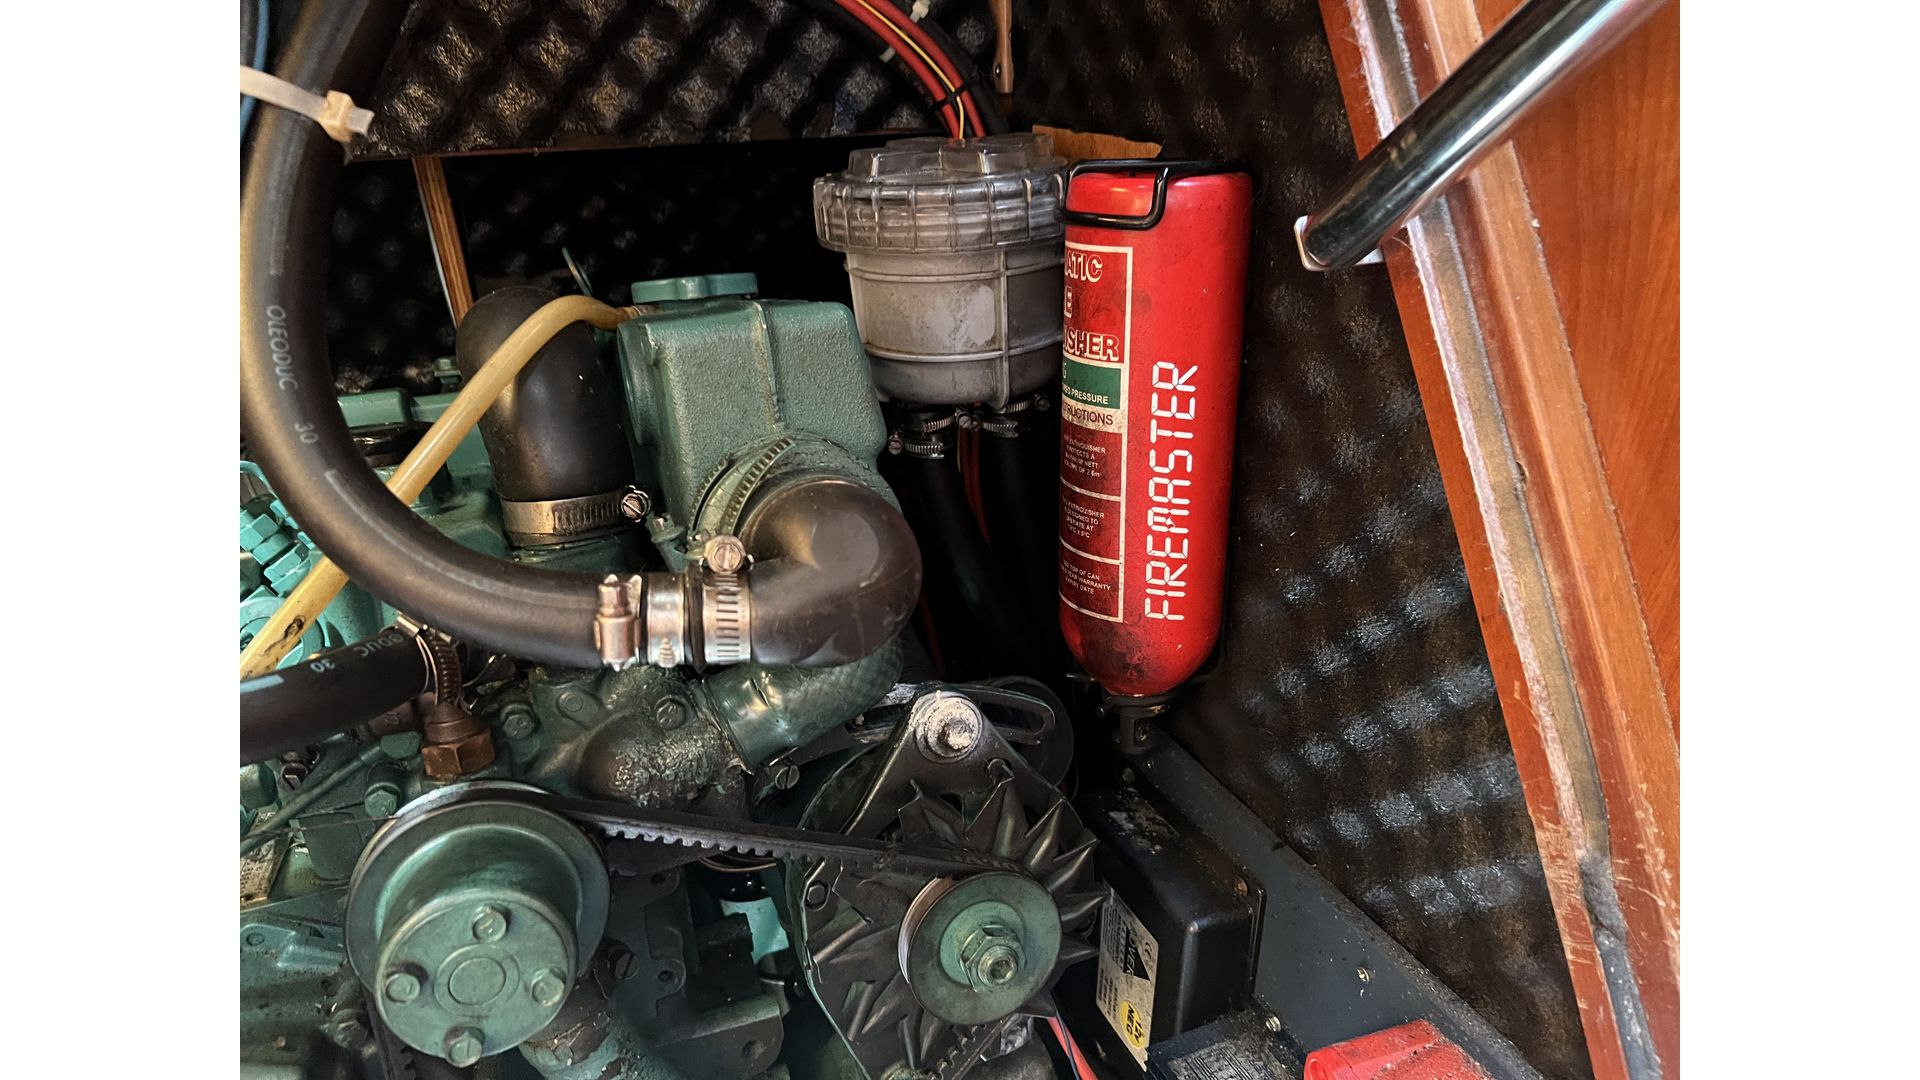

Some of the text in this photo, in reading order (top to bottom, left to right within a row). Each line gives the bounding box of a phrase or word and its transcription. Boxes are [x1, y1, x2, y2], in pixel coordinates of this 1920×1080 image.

[266, 305, 319, 444] OLEODUC 30
[1071, 388, 1109, 405] PRESSURE
[1144, 361, 1198, 621] FIREMASTER
[1086, 524, 1094, 532] AT
[1090, 517, 1099, 526] TO
[1078, 577, 1111, 591] WARRANTY
[1080, 584, 1095, 595] DATE
[310, 659, 336, 673] 30
[1126, 1004, 1135, 1035] NEG
